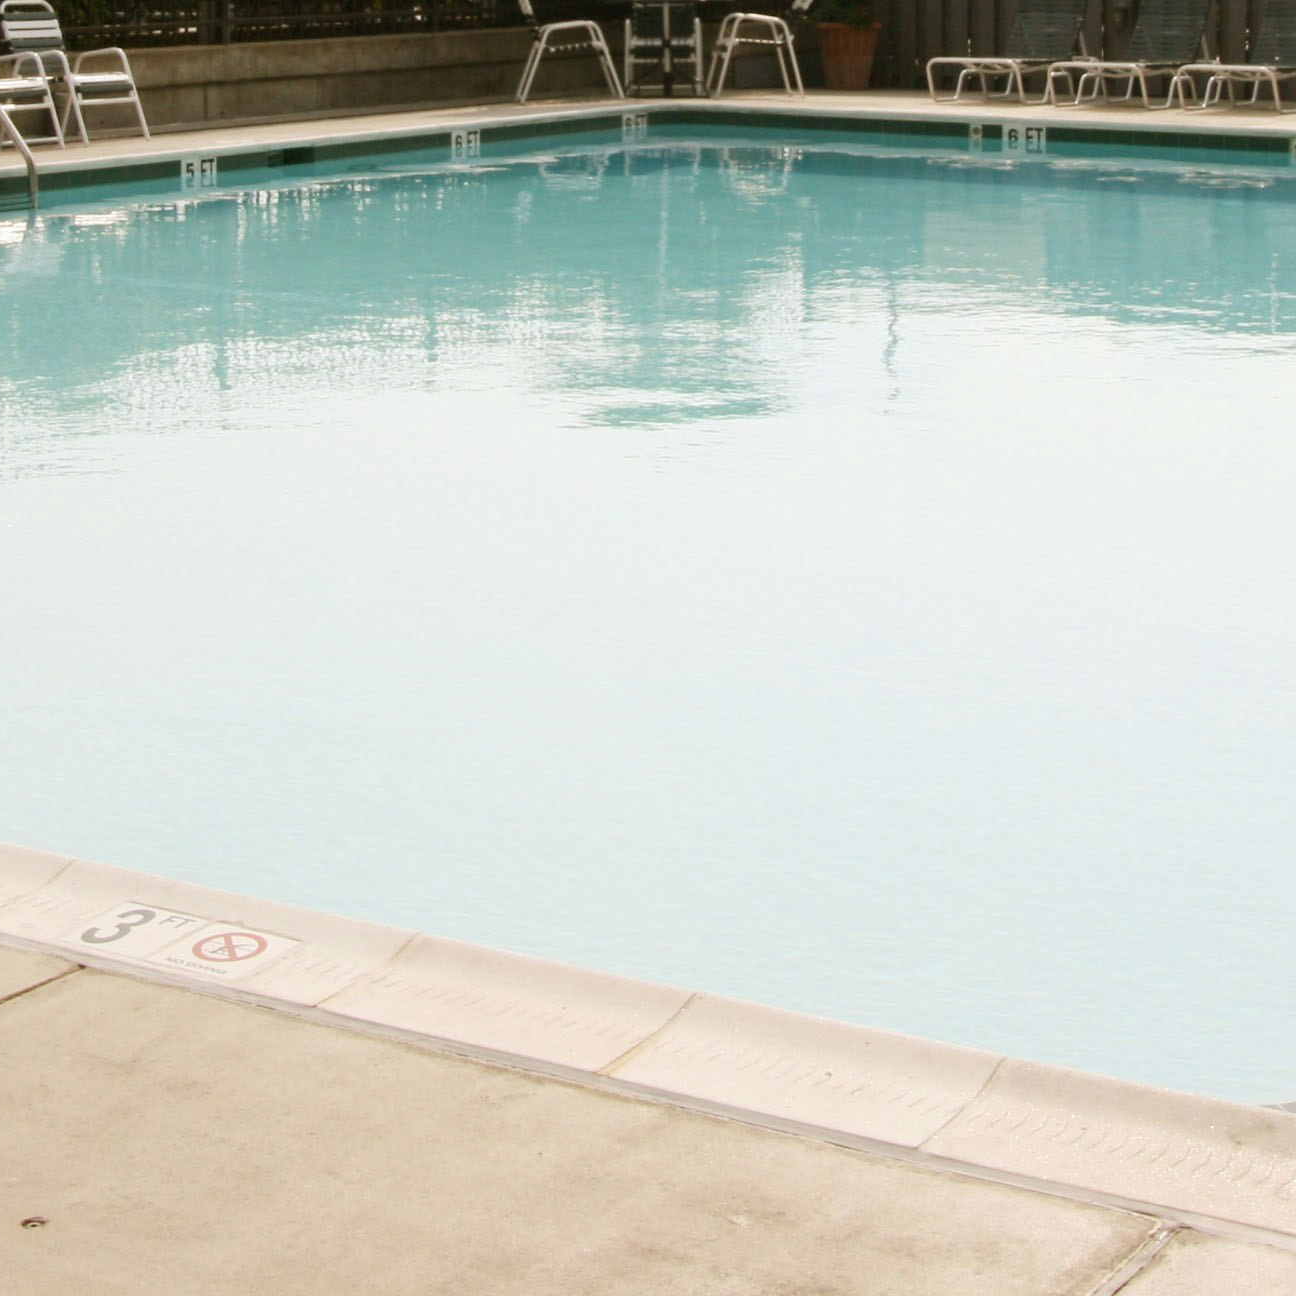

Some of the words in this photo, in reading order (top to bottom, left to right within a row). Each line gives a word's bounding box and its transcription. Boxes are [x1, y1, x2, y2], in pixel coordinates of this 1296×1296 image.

[1025, 127, 1044, 142] FT
[201, 158, 215, 177] FT
[80, 909, 156, 944] 3
[158, 915, 197, 929] FT
